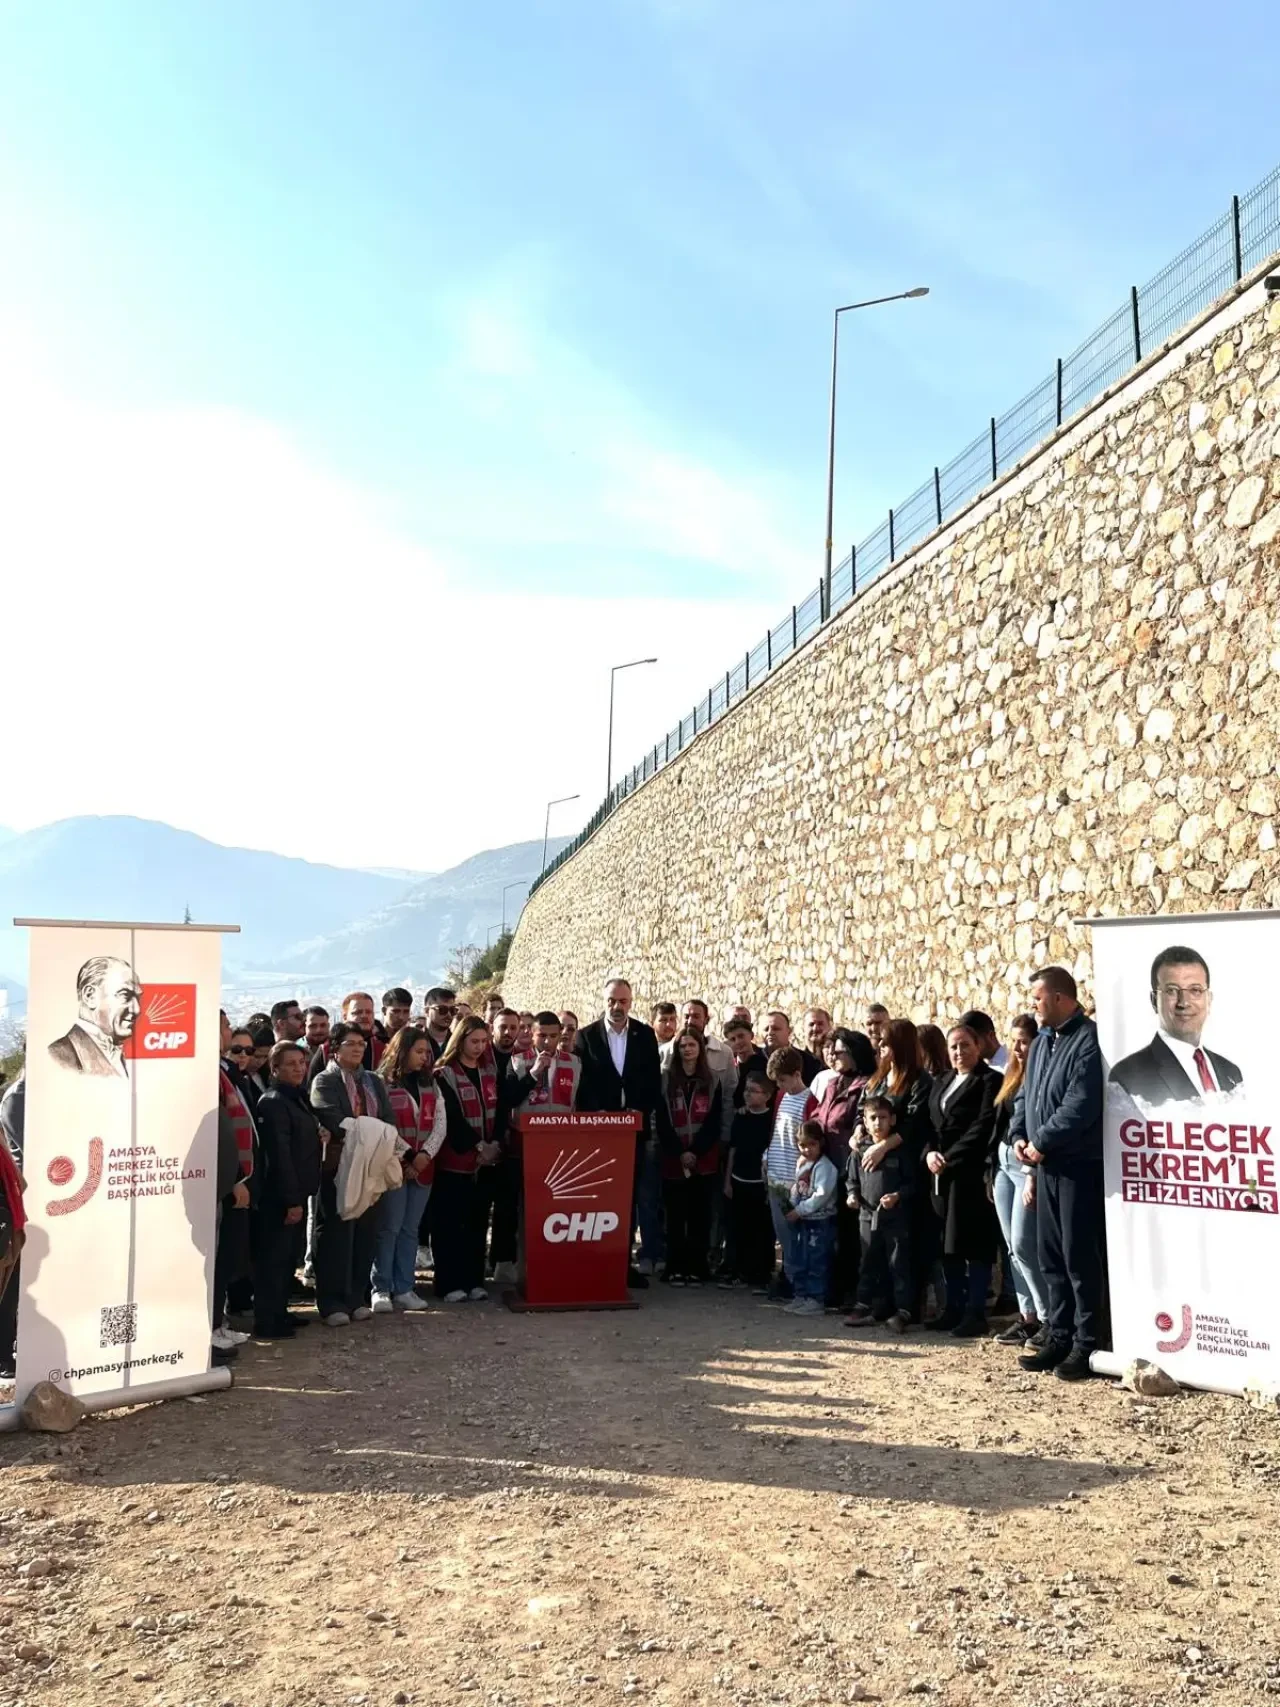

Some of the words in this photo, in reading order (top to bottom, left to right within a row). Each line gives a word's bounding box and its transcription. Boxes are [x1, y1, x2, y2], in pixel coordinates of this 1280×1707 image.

[144, 1031, 188, 1050] CHP
[529, 1116, 568, 1125] AMASYA
[570, 1114, 578, 1125] İL
[580, 1115, 635, 1126] BAŞKANLIĞI
[1119, 1118, 1274, 1155] GELECEK
[108, 1146, 156, 1158] AMASYA
[108, 1160, 153, 1172] MERKEZ
[156, 1156, 179, 1170] İLÇE
[1121, 1151, 1276, 1187] EKREM'LE
[108, 1171, 156, 1185] GENÇLİK
[159, 1169, 206, 1182] KOLLARI
[107, 1183, 175, 1201] BAŞKANLIĞI
[543, 1211, 619, 1243] CHP
[1195, 1314, 1230, 1325] AMASYA
[1196, 1324, 1228, 1335] MERKEZ
[1230, 1327, 1249, 1338] İLÇE
[1196, 1332, 1232, 1345] GENÇLİK
[1233, 1338, 1271, 1351] KOLLARI
[1197, 1343, 1248, 1358] BAŞKANLIĞI
[64, 1350, 184, 1380] chpamasyamerkezgk
